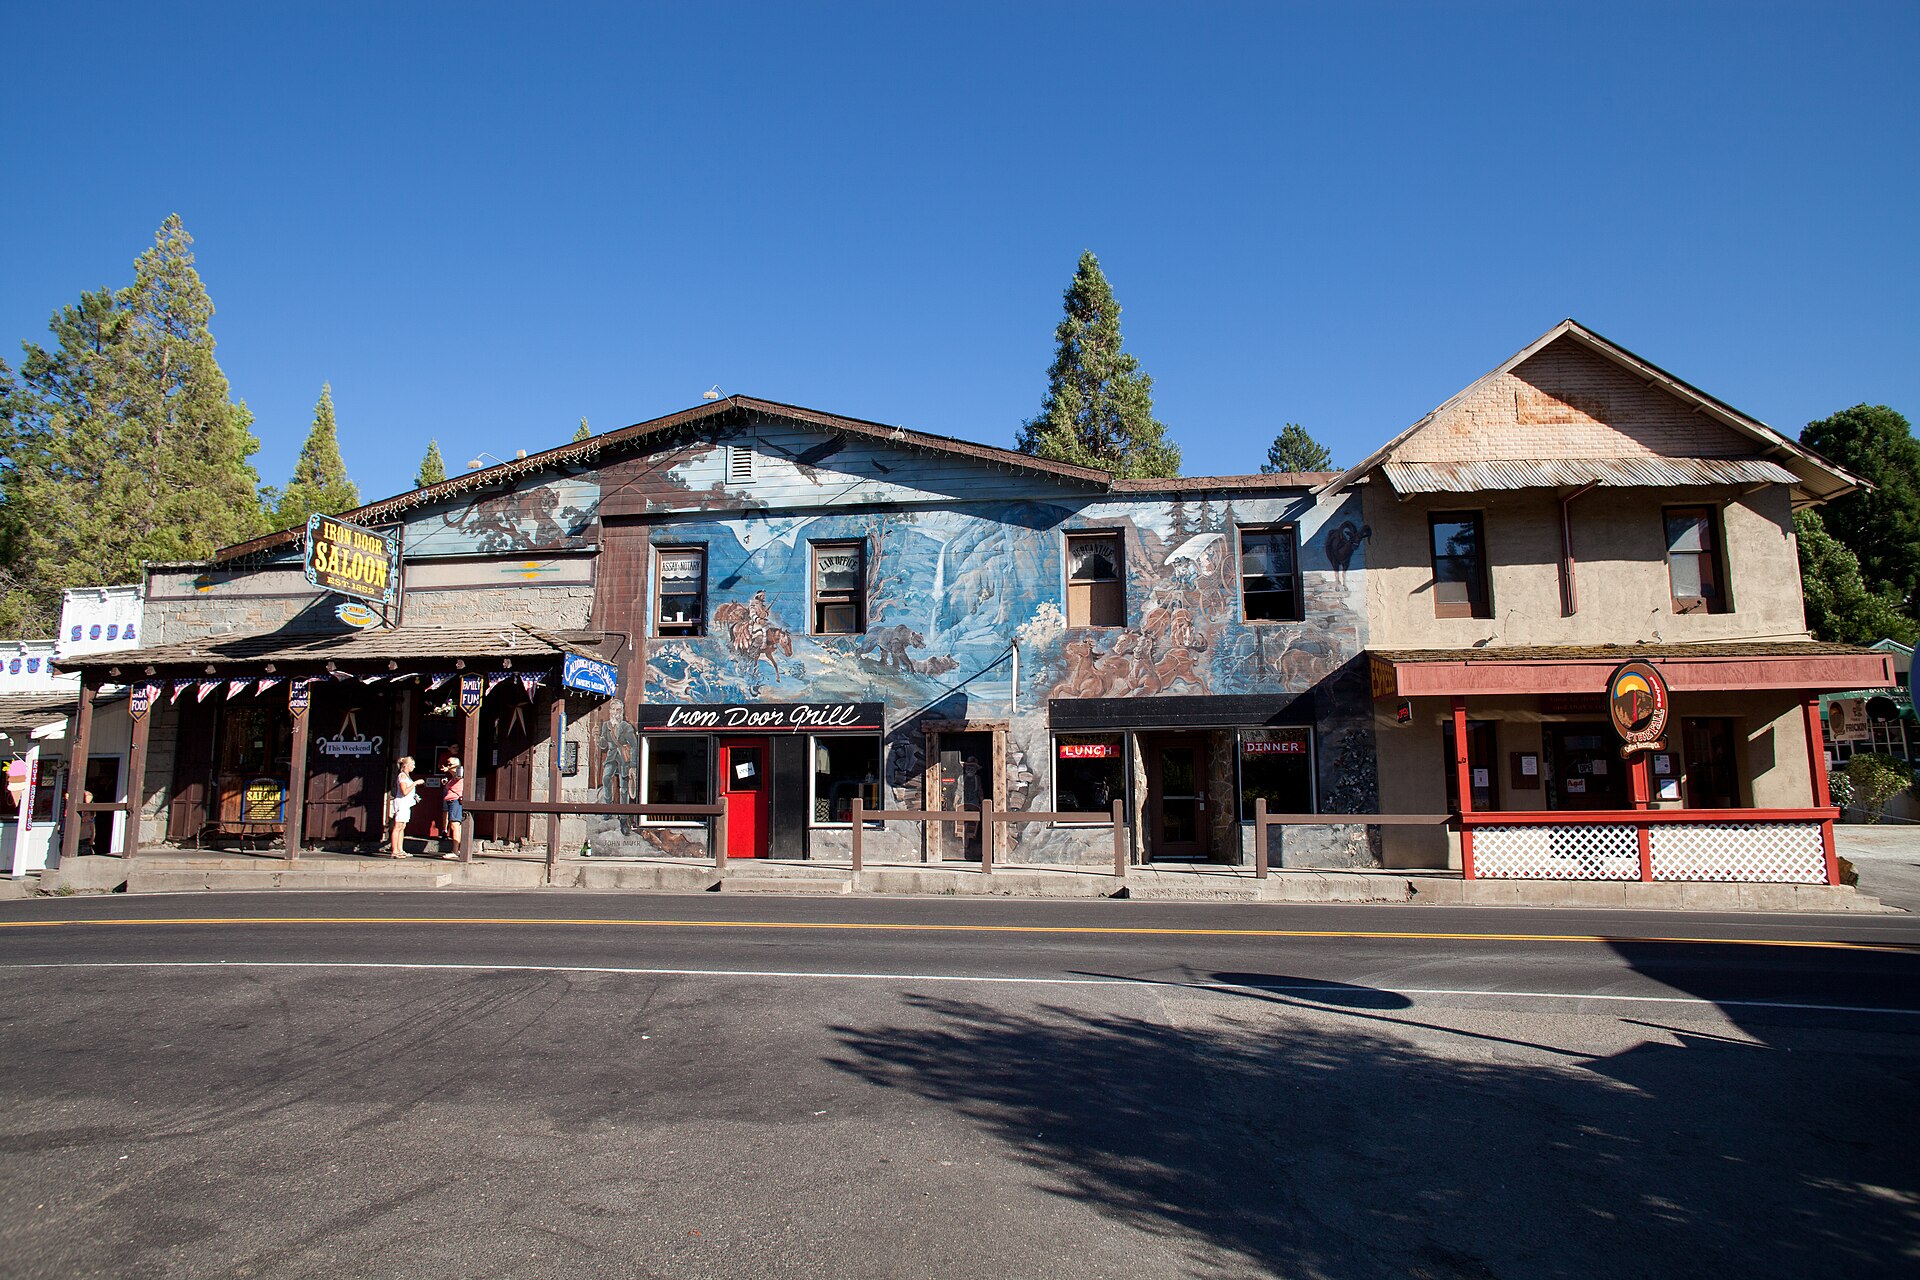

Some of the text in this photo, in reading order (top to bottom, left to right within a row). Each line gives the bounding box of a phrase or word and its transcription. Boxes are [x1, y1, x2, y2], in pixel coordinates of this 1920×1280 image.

[324, 521, 383, 556] IRON DOOR
[315, 541, 388, 588] SALOON
[819, 555, 858, 571] LAW OFFICE
[71, 623, 136, 642] SODA
[463, 677, 482, 690] FAMILY
[131, 699, 149, 711] FOOD
[462, 693, 480, 705] FUN
[667, 705, 861, 735] Iron Door Grill
[1626, 709, 1665, 742] FIREFALL
[1066, 746, 1112, 756] LUNCH
[1246, 742, 1299, 752] DINNER
[246, 791, 281, 801] SALOON
